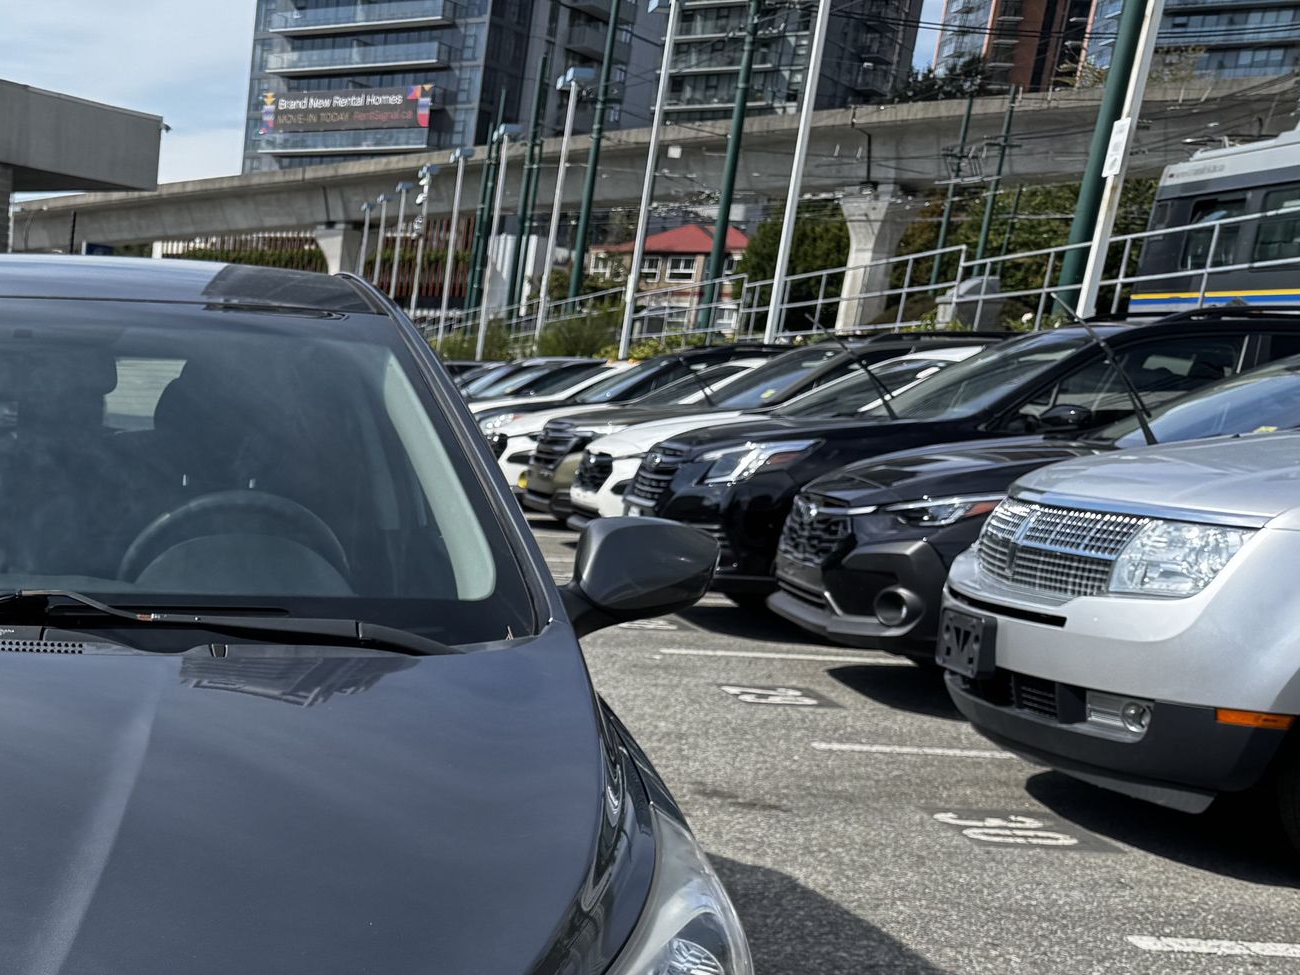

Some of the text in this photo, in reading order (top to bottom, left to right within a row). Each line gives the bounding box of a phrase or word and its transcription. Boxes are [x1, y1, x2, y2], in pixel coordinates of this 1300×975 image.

[278, 93, 403, 110] Brand New Rental Homes
[933, 812, 1079, 846] 30
